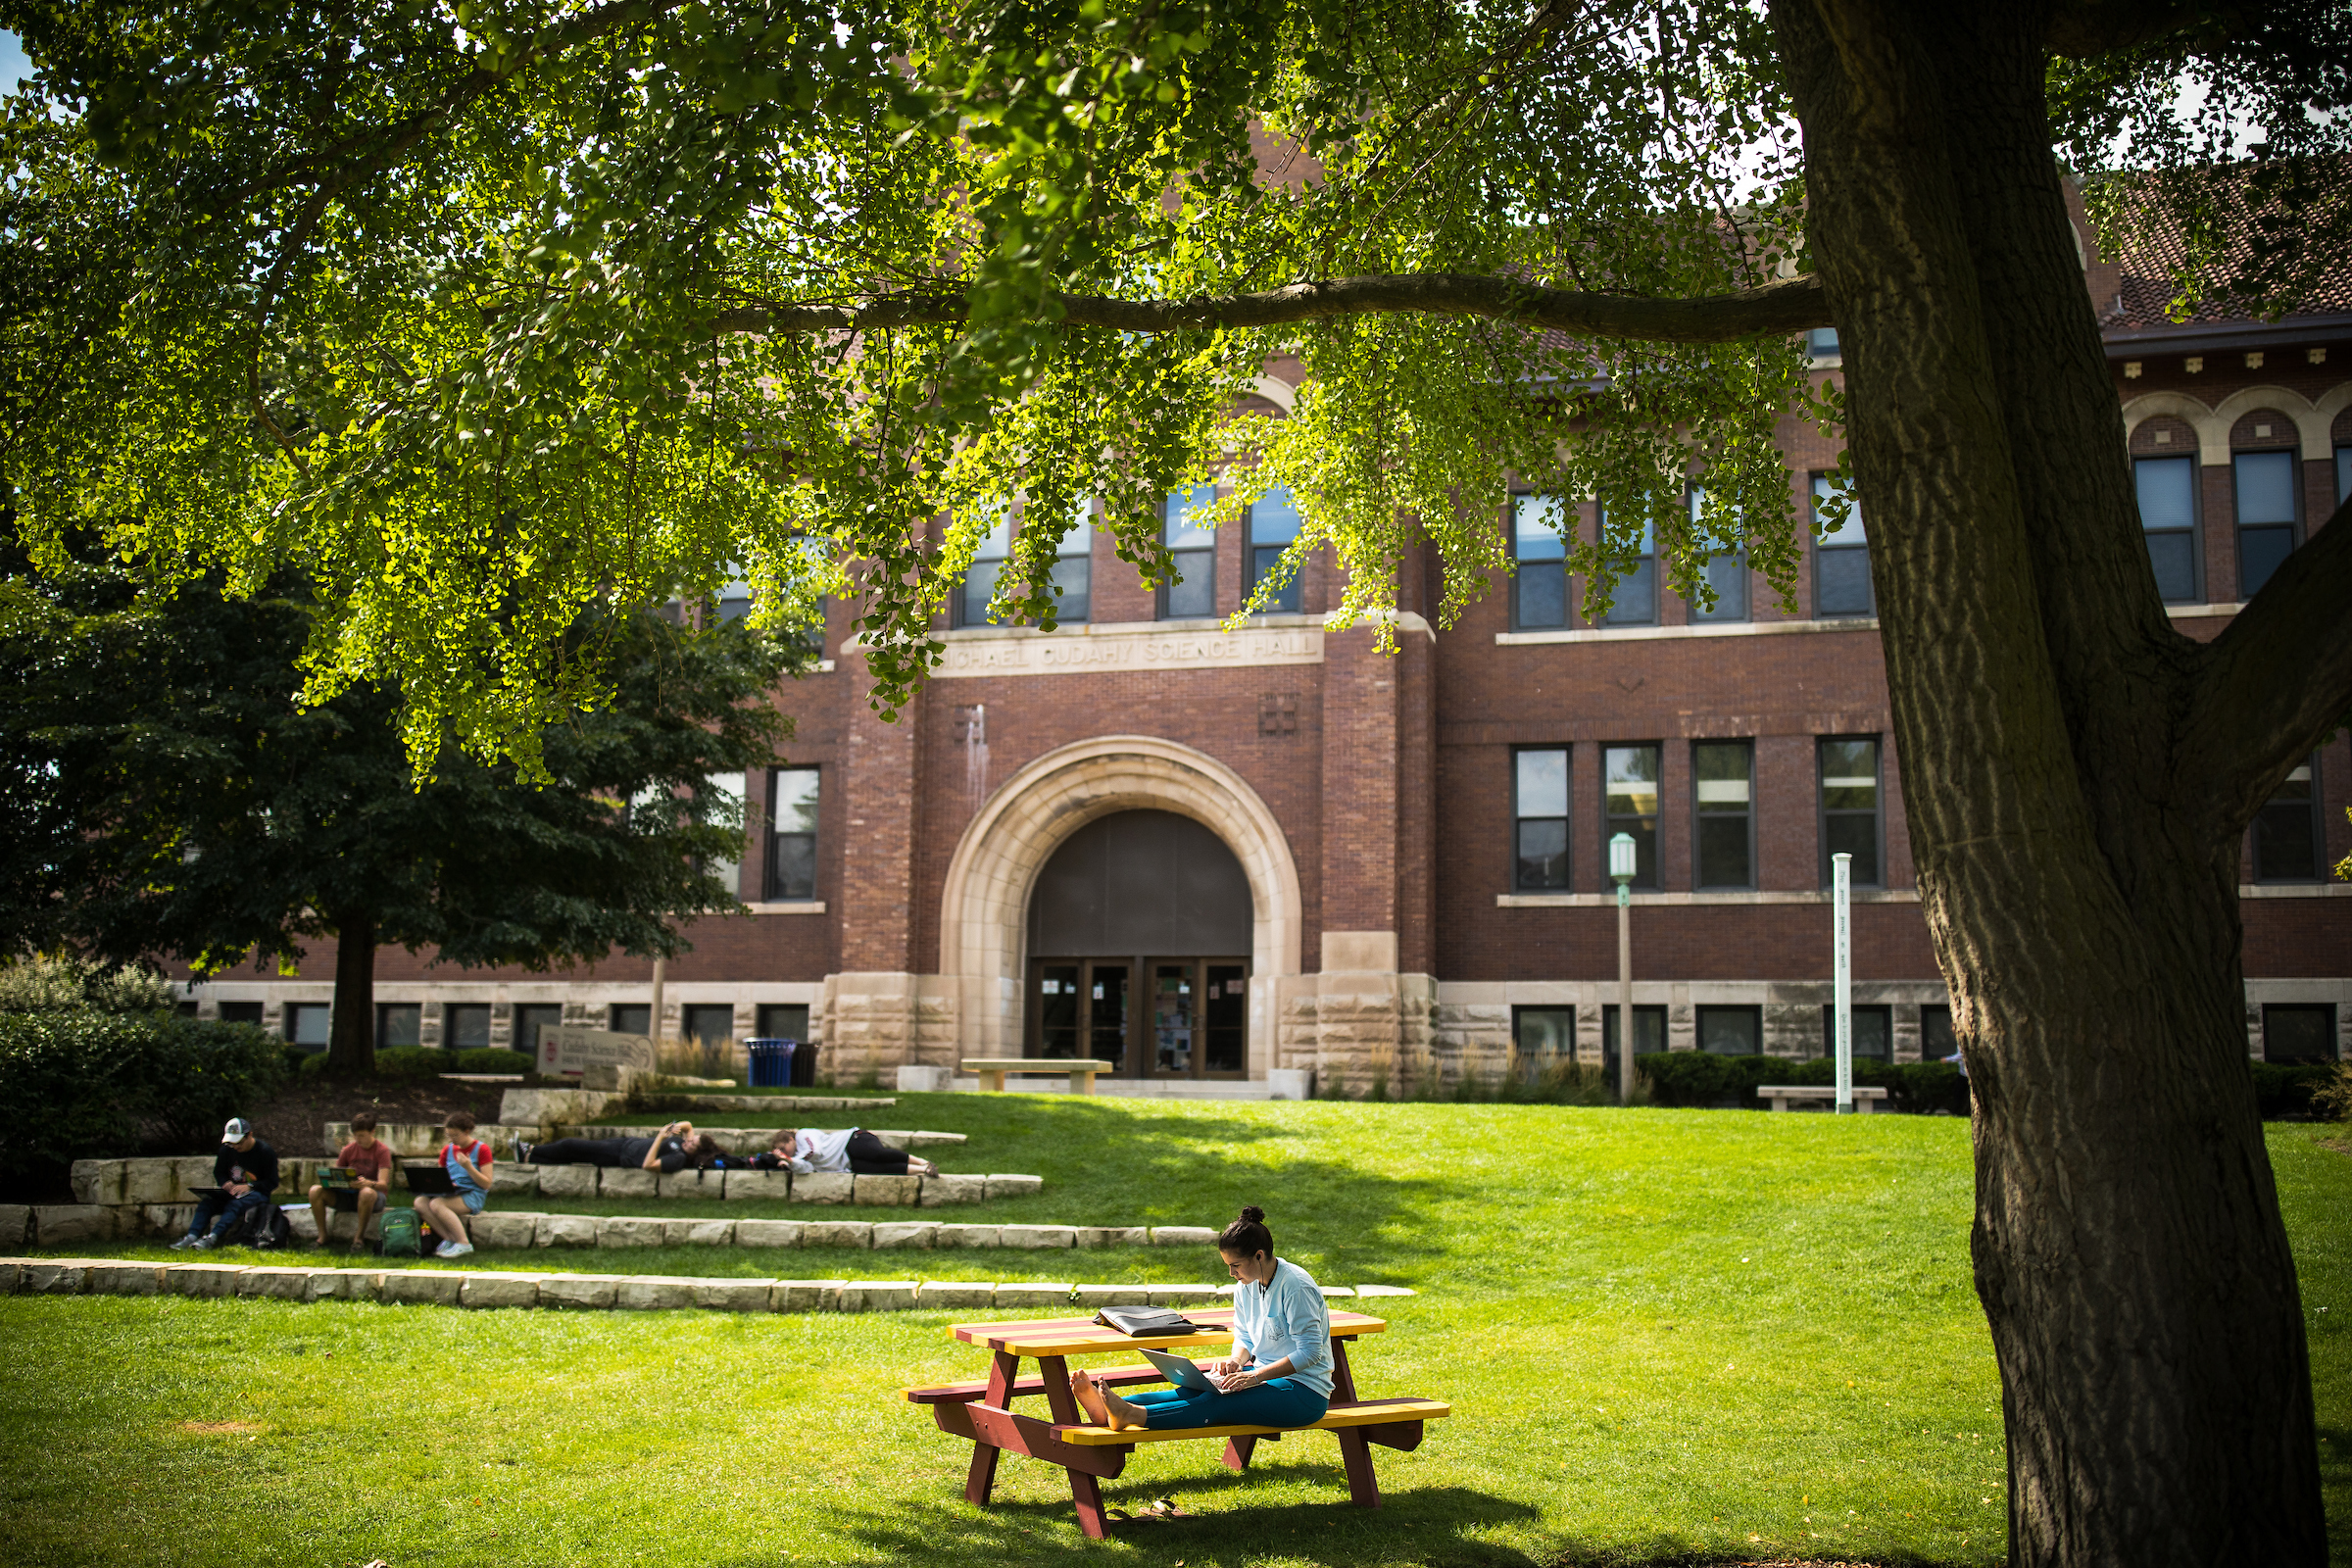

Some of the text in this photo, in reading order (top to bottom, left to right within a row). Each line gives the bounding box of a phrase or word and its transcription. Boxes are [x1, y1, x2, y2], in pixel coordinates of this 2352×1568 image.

[1043, 643, 1134, 665] CUDAHY
[1145, 639, 1240, 662] SCIENCE
[1252, 636, 1317, 658] HALL
